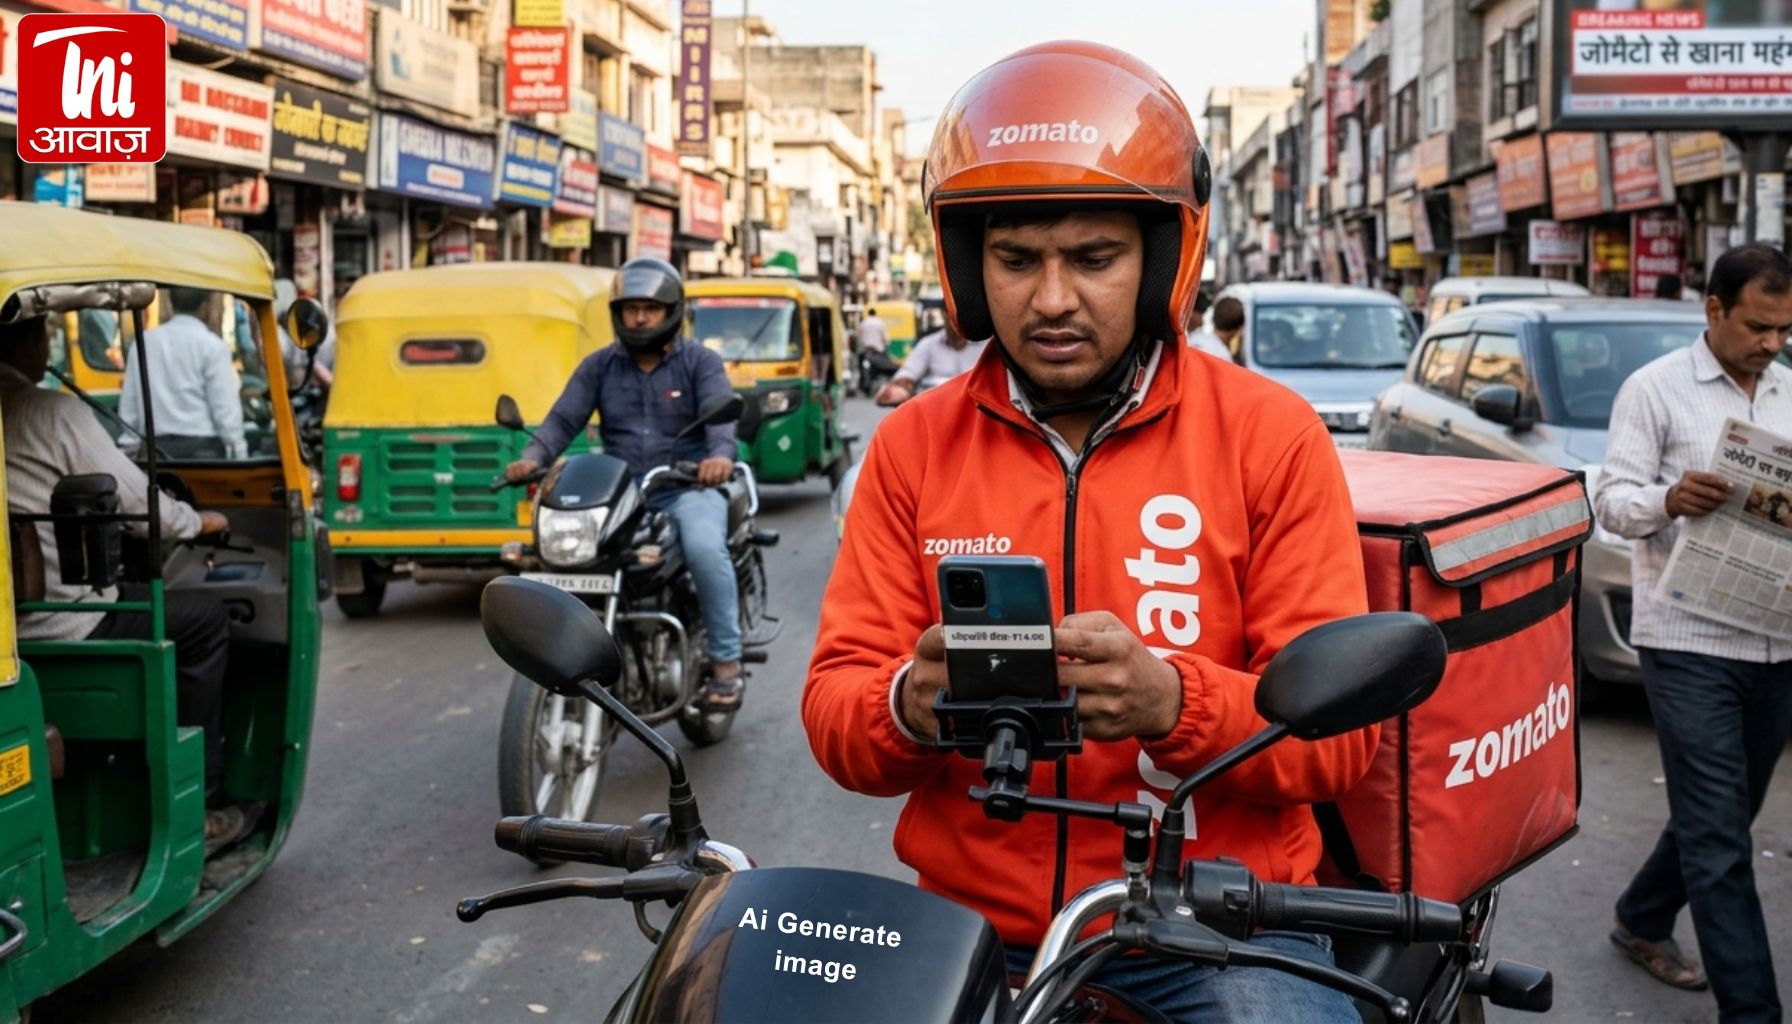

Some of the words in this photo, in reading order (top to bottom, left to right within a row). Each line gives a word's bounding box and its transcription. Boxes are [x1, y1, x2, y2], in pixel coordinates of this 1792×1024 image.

[1655, 13, 1700, 27] NEWS
[1580, 35, 1652, 64] जोमैटो
[1660, 35, 1681, 64] से
[1689, 41, 1744, 64] खाना
[987, 120, 1099, 148] zomato
[924, 533, 1012, 556] zomato
[1445, 681, 1570, 789] zomato
